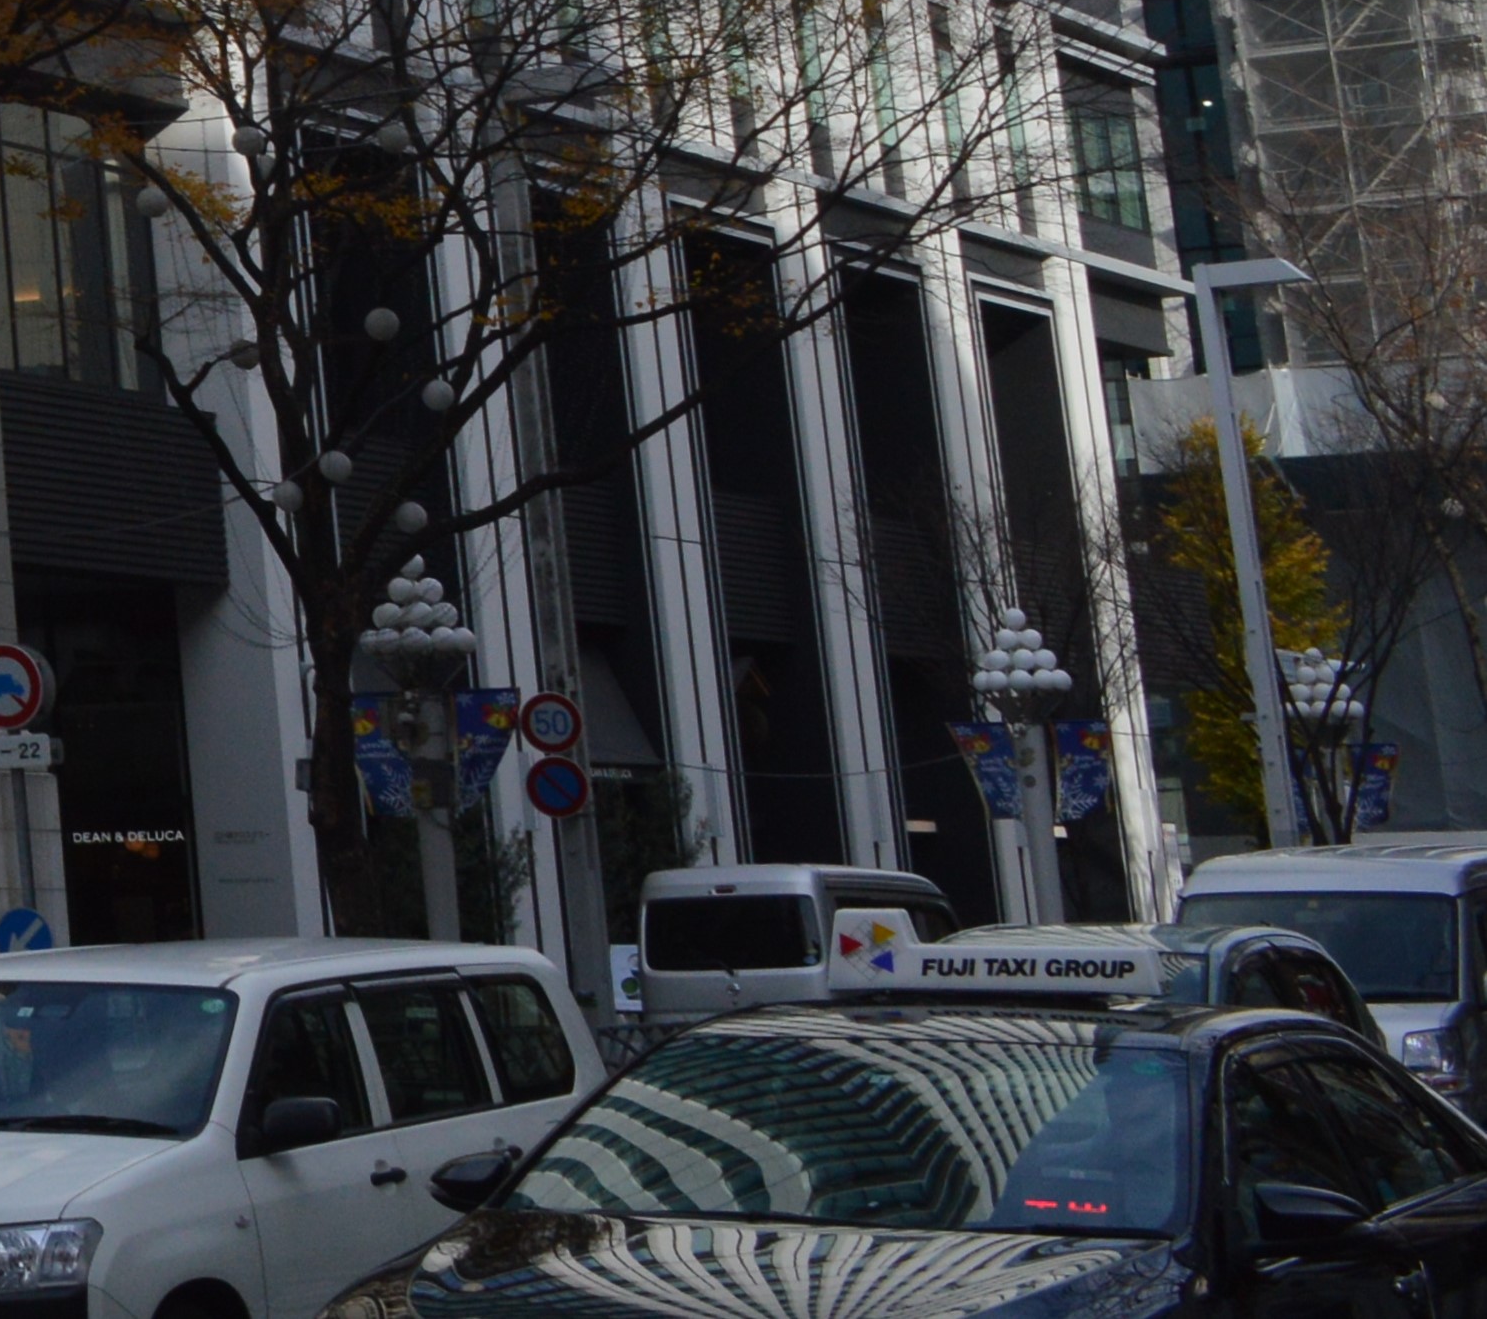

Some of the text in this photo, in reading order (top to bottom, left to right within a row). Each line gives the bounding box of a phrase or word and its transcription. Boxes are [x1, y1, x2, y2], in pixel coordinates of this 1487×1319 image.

[534, 710, 569, 736] 50
[72, 830, 185, 843] DEAN & DELUCA
[922, 958, 1135, 978] FUJI TAXI GROUP
